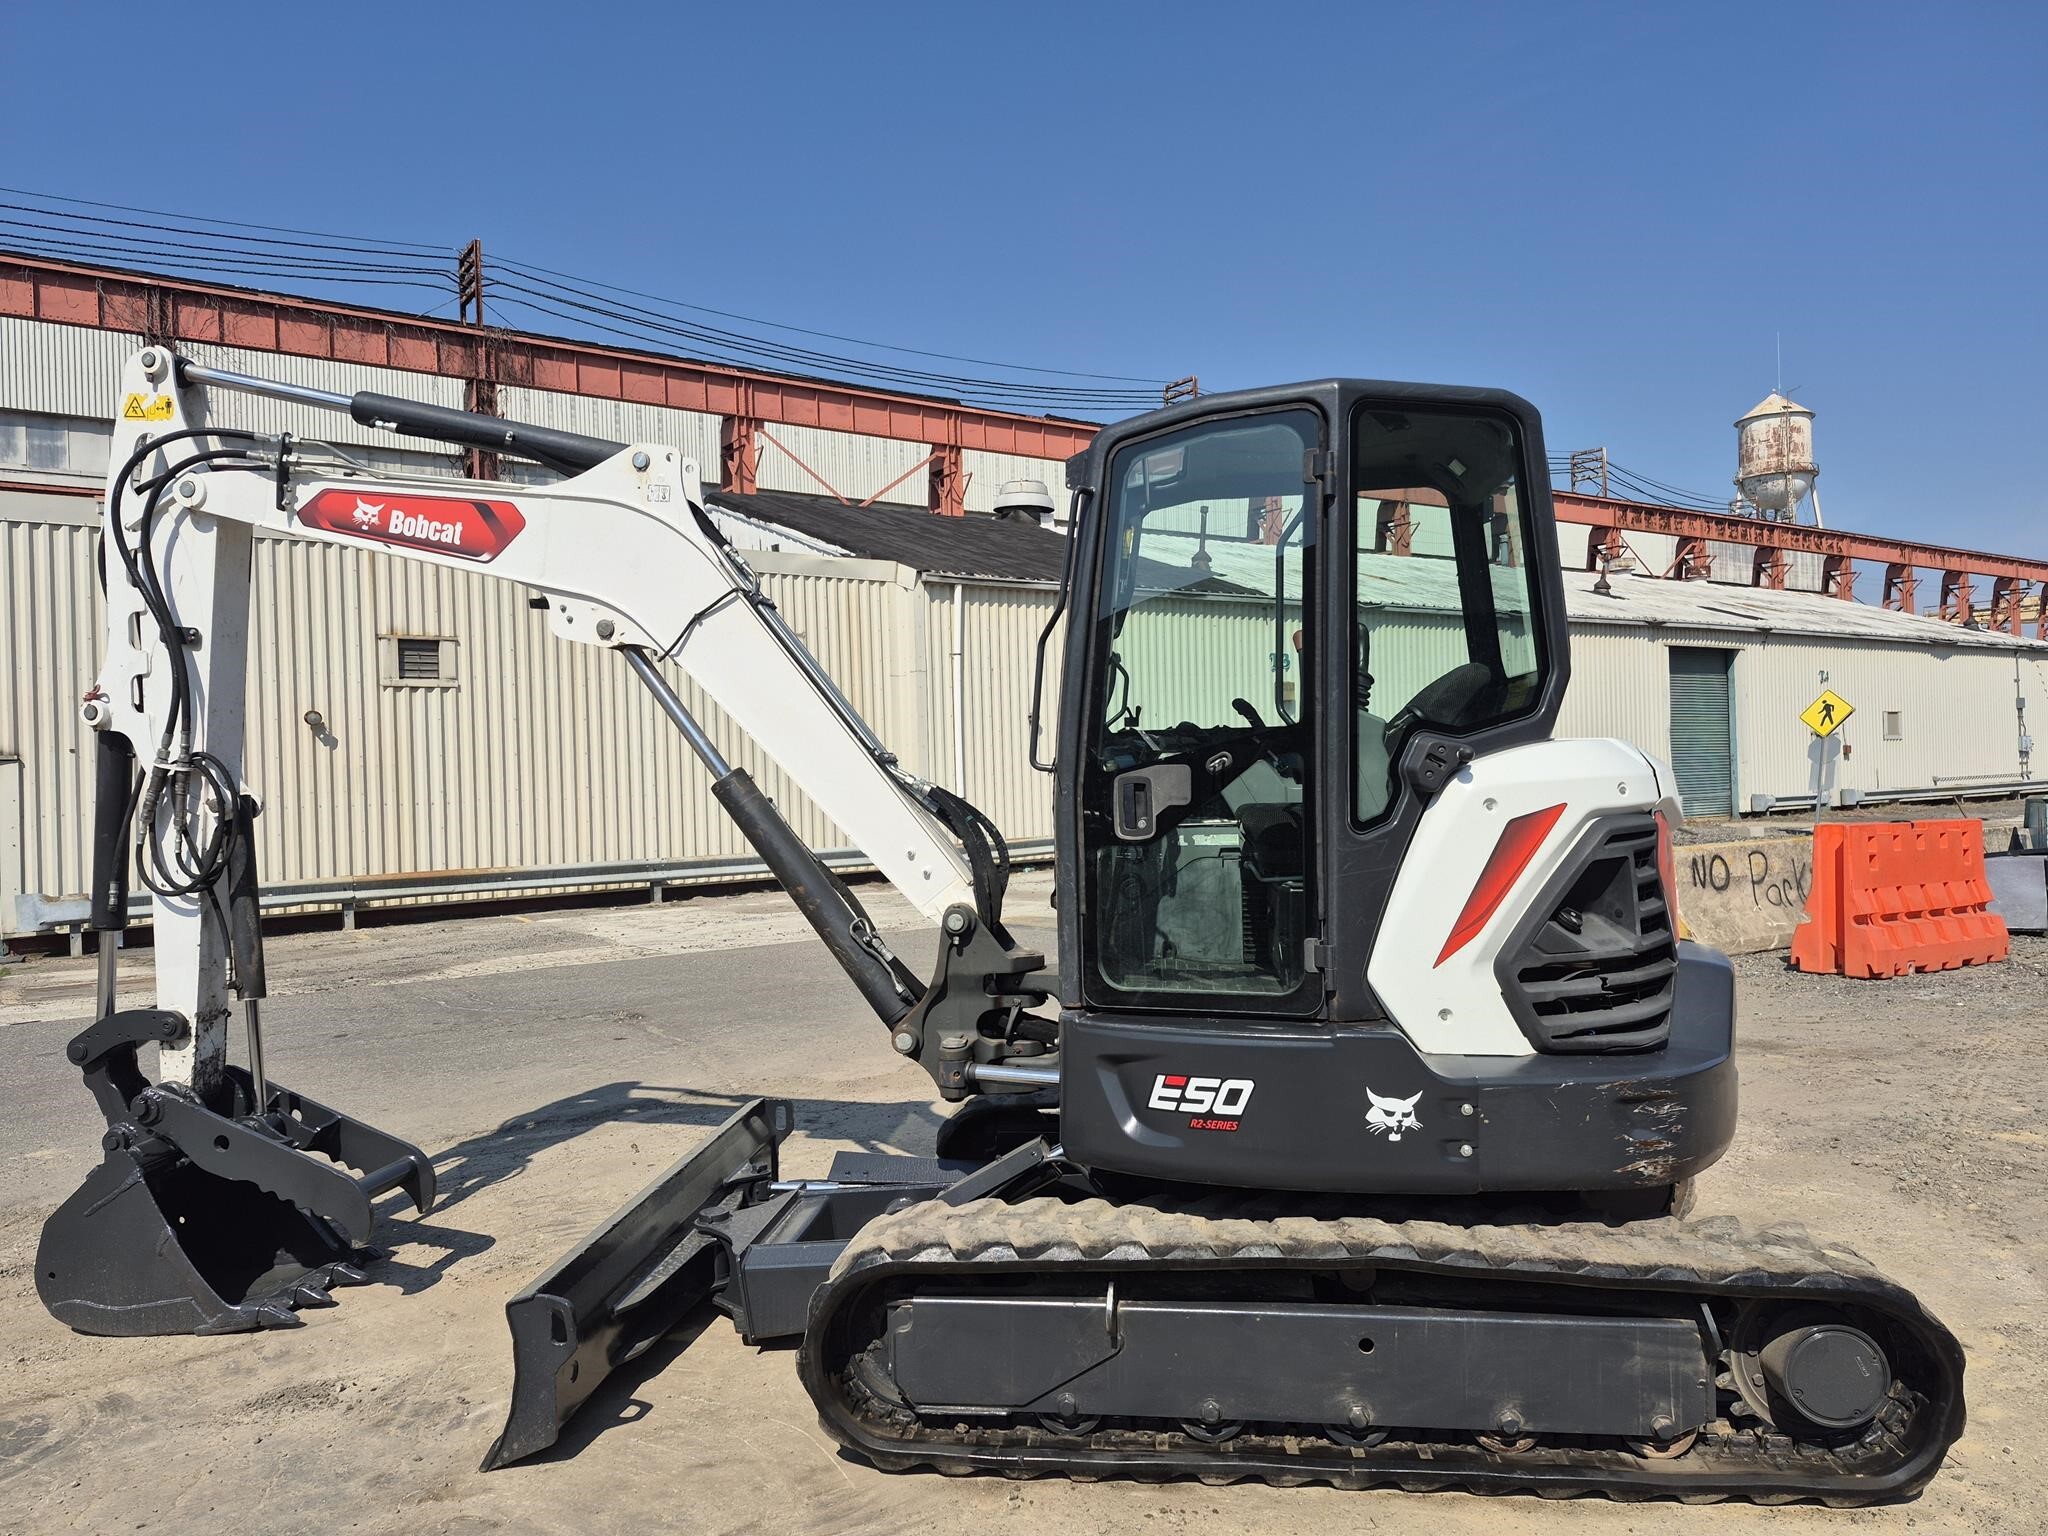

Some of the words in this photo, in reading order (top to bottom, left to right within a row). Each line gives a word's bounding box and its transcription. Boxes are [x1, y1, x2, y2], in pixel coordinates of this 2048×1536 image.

[389, 509, 463, 545] Bobcat
[1691, 854, 1730, 891] NO
[1148, 1074, 1255, 1116] E50
[1190, 1119, 1239, 1131] R2-SERIES
